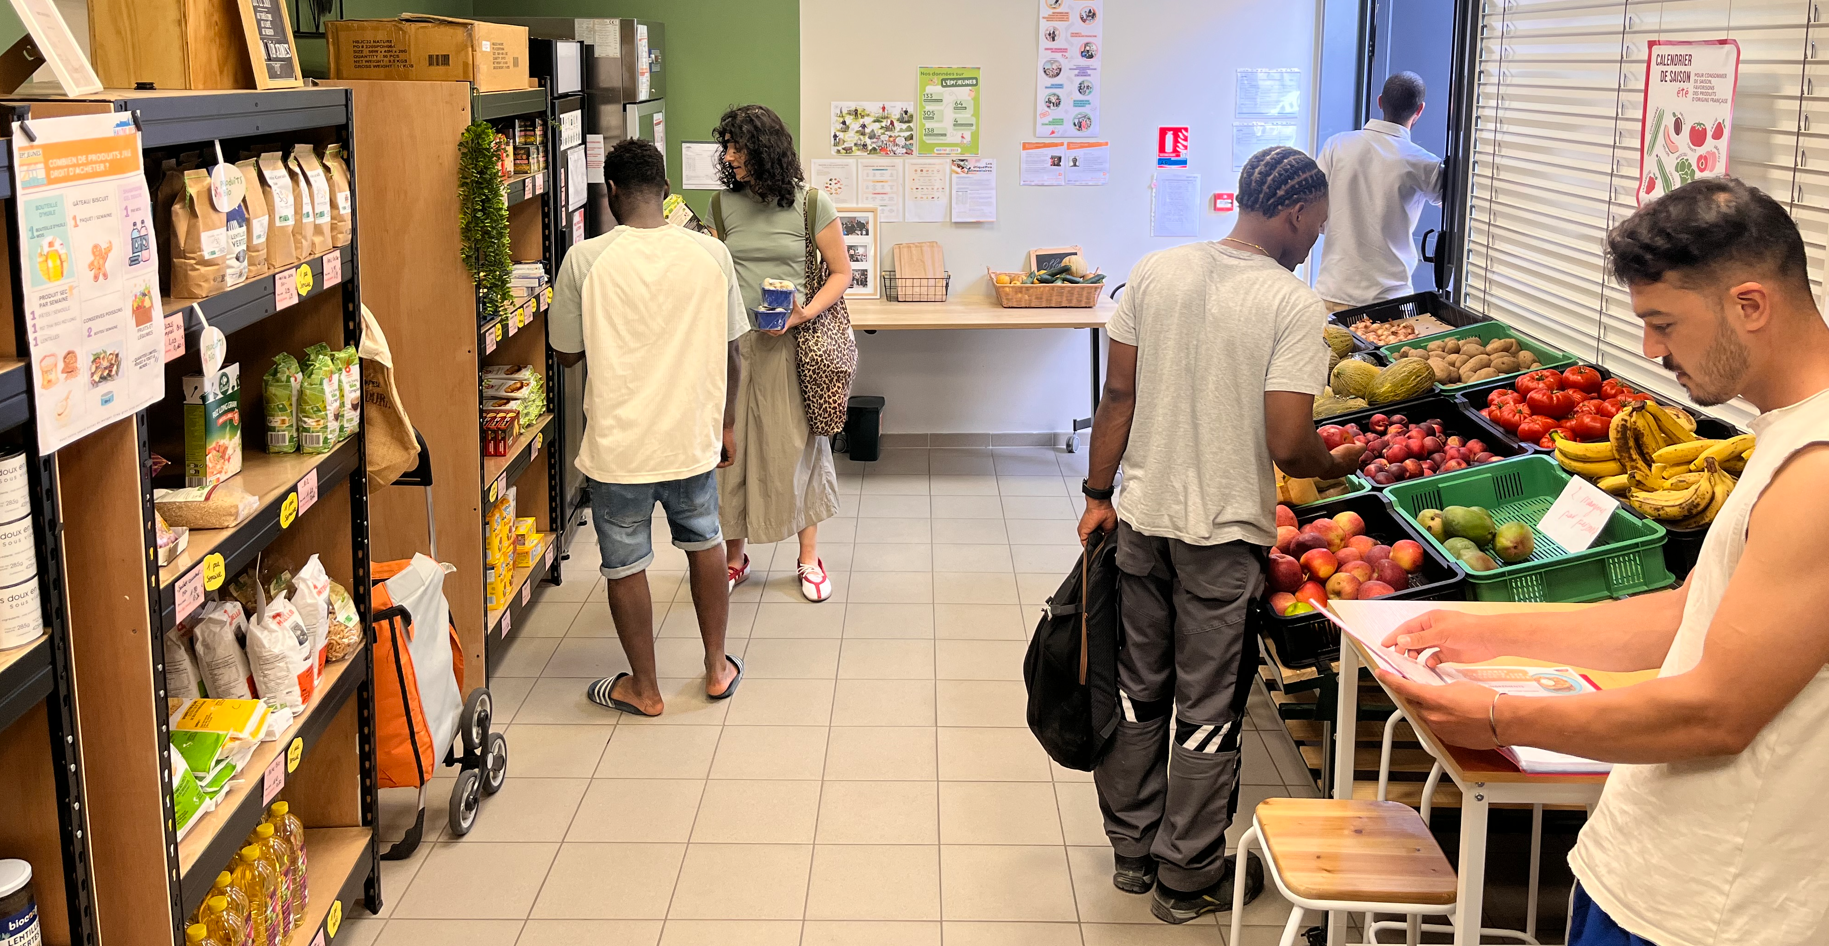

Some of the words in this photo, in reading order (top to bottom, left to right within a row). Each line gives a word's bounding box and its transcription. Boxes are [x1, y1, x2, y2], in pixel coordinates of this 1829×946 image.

[1656, 54, 1692, 66] CALENDRIER
[1660, 70, 1668, 82] DE
[1670, 70, 1691, 83] SAISON
[1677, 87, 1689, 98] été
[49, 157, 77, 168] COMBIEN
[88, 152, 120, 163] PRODUITS
[50, 168, 68, 179] DROIT
[69, 164, 104, 176] D'ACHETER
[35, 201, 58, 211] BOUTEILLE
[124, 206, 129, 217] 1
[72, 215, 79, 228] 1
[29, 226, 35, 239] 1
[38, 291, 58, 301] PRODUIT
[49, 296, 68, 306] SEMAINE
[30, 310, 36, 320] 1
[83, 313, 104, 324] CONSERVES
[104, 307, 123, 318] POISSONS
[32, 323, 38, 334] 1
[87, 327, 92, 338] 2
[33, 336, 39, 347] 1
[0, 530, 22, 541] doux
[8, 591, 29, 603] doux
[30, 586, 37, 595] en
